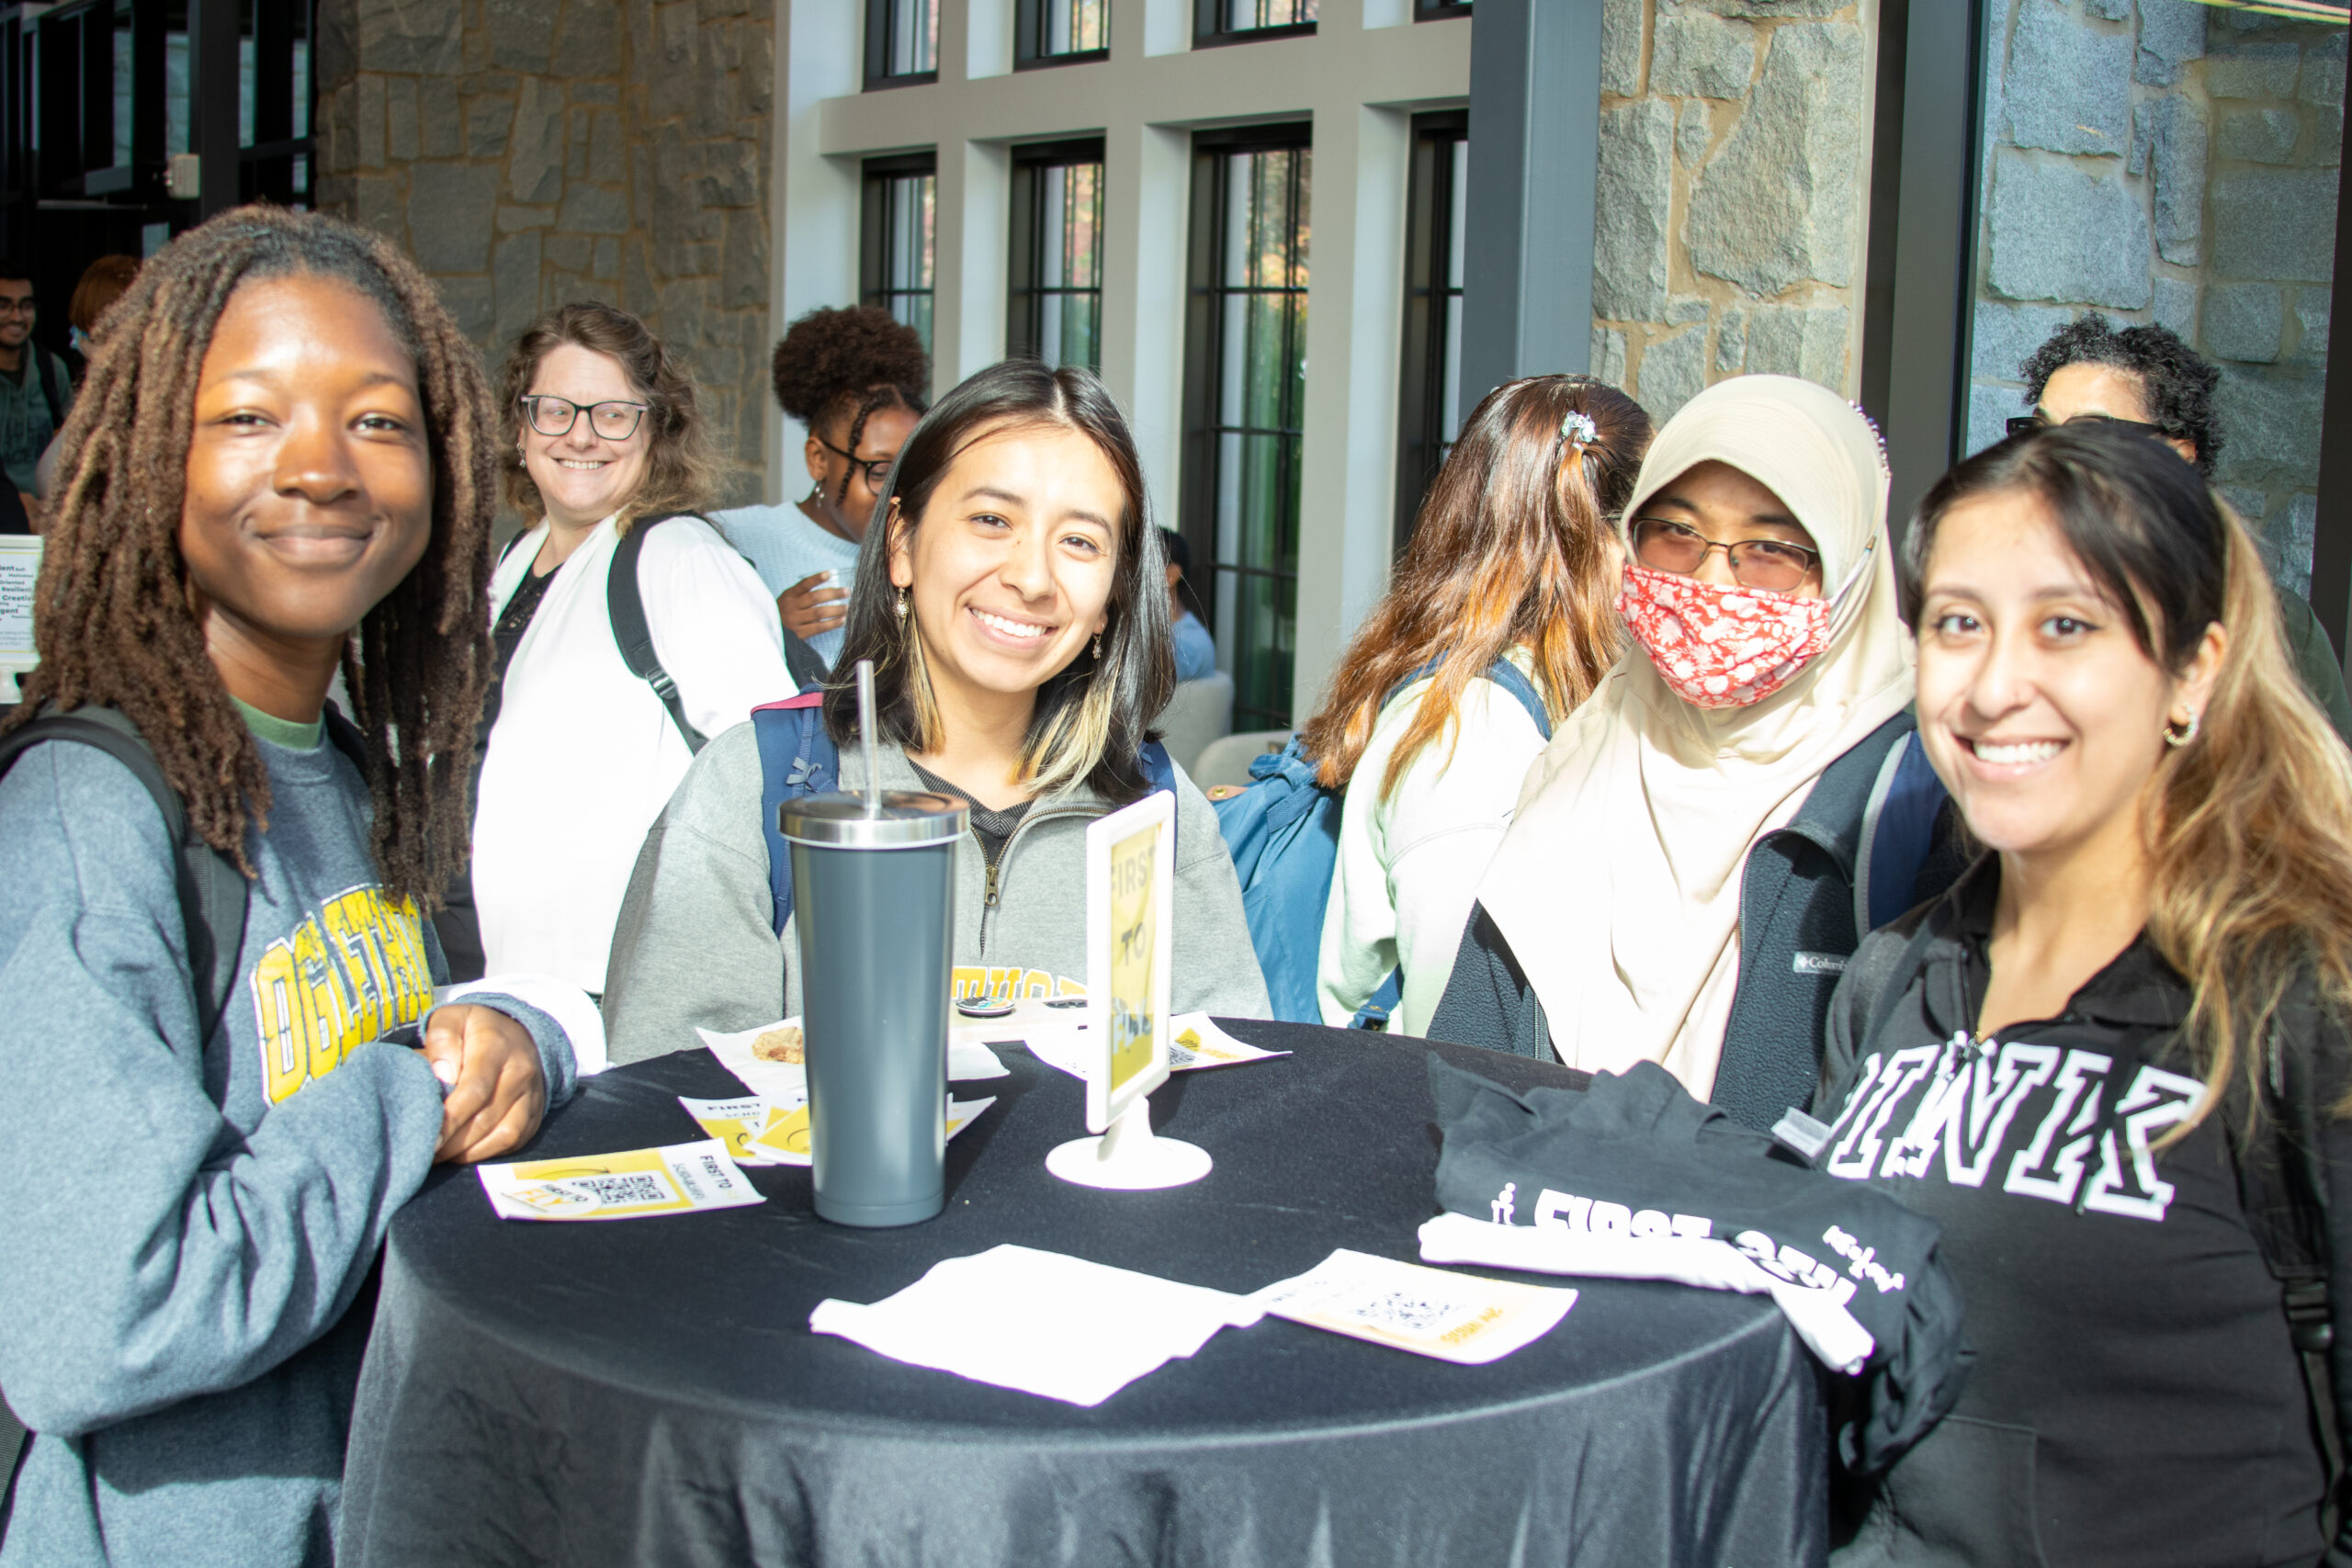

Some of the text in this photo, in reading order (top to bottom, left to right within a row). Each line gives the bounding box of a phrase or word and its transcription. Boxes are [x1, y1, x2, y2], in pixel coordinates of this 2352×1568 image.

[1120, 920, 1147, 968] TO
[1826, 1031, 2209, 1222] INK
[716, 1179, 733, 1189] TO
